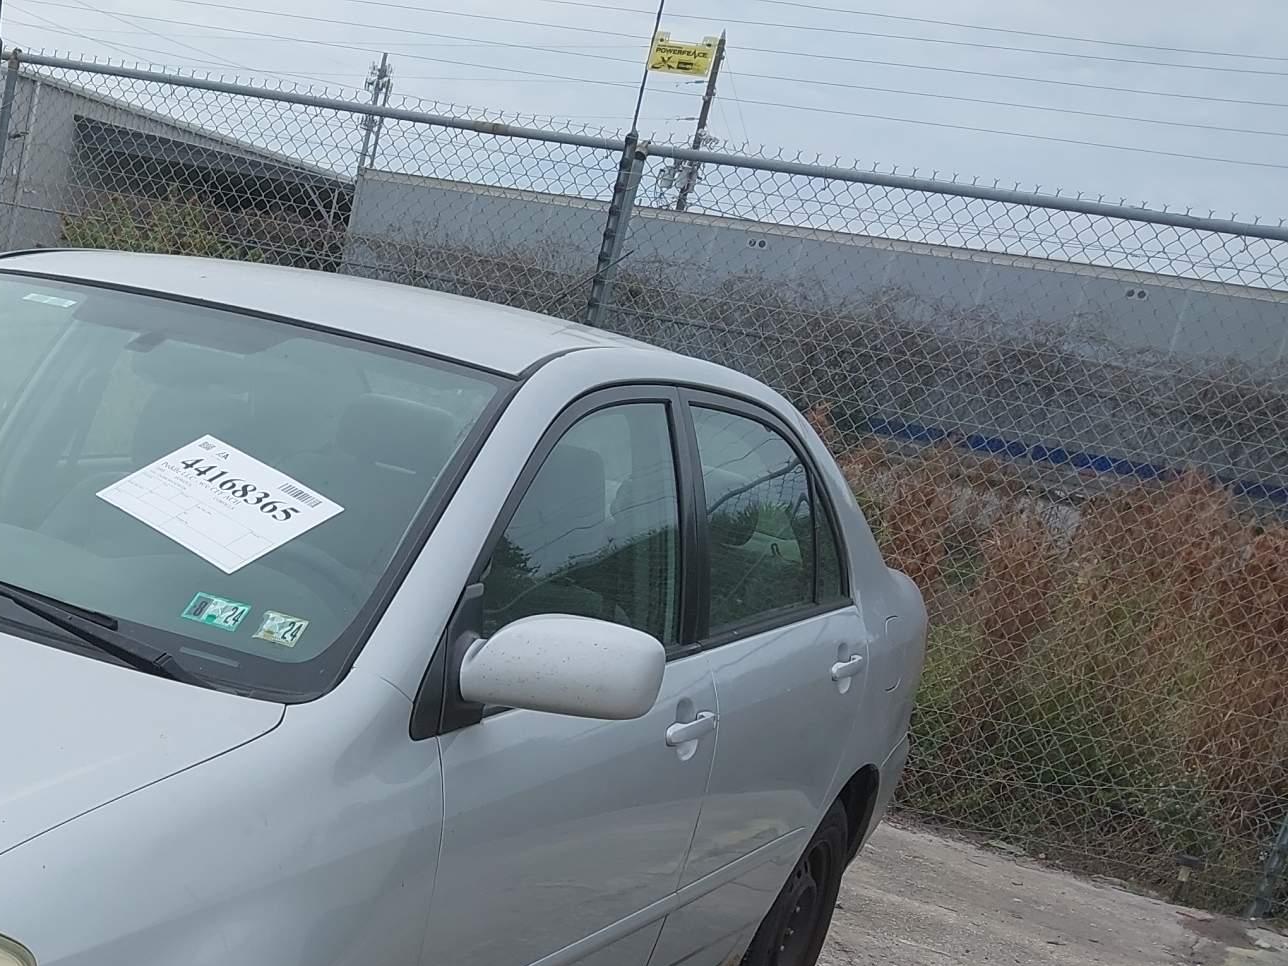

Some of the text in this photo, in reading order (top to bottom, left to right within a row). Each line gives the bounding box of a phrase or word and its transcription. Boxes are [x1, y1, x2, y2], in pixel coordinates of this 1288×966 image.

[181, 458, 301, 521] 44168365
[193, 600, 245, 625] 8 24
[281, 621, 303, 641] 24
